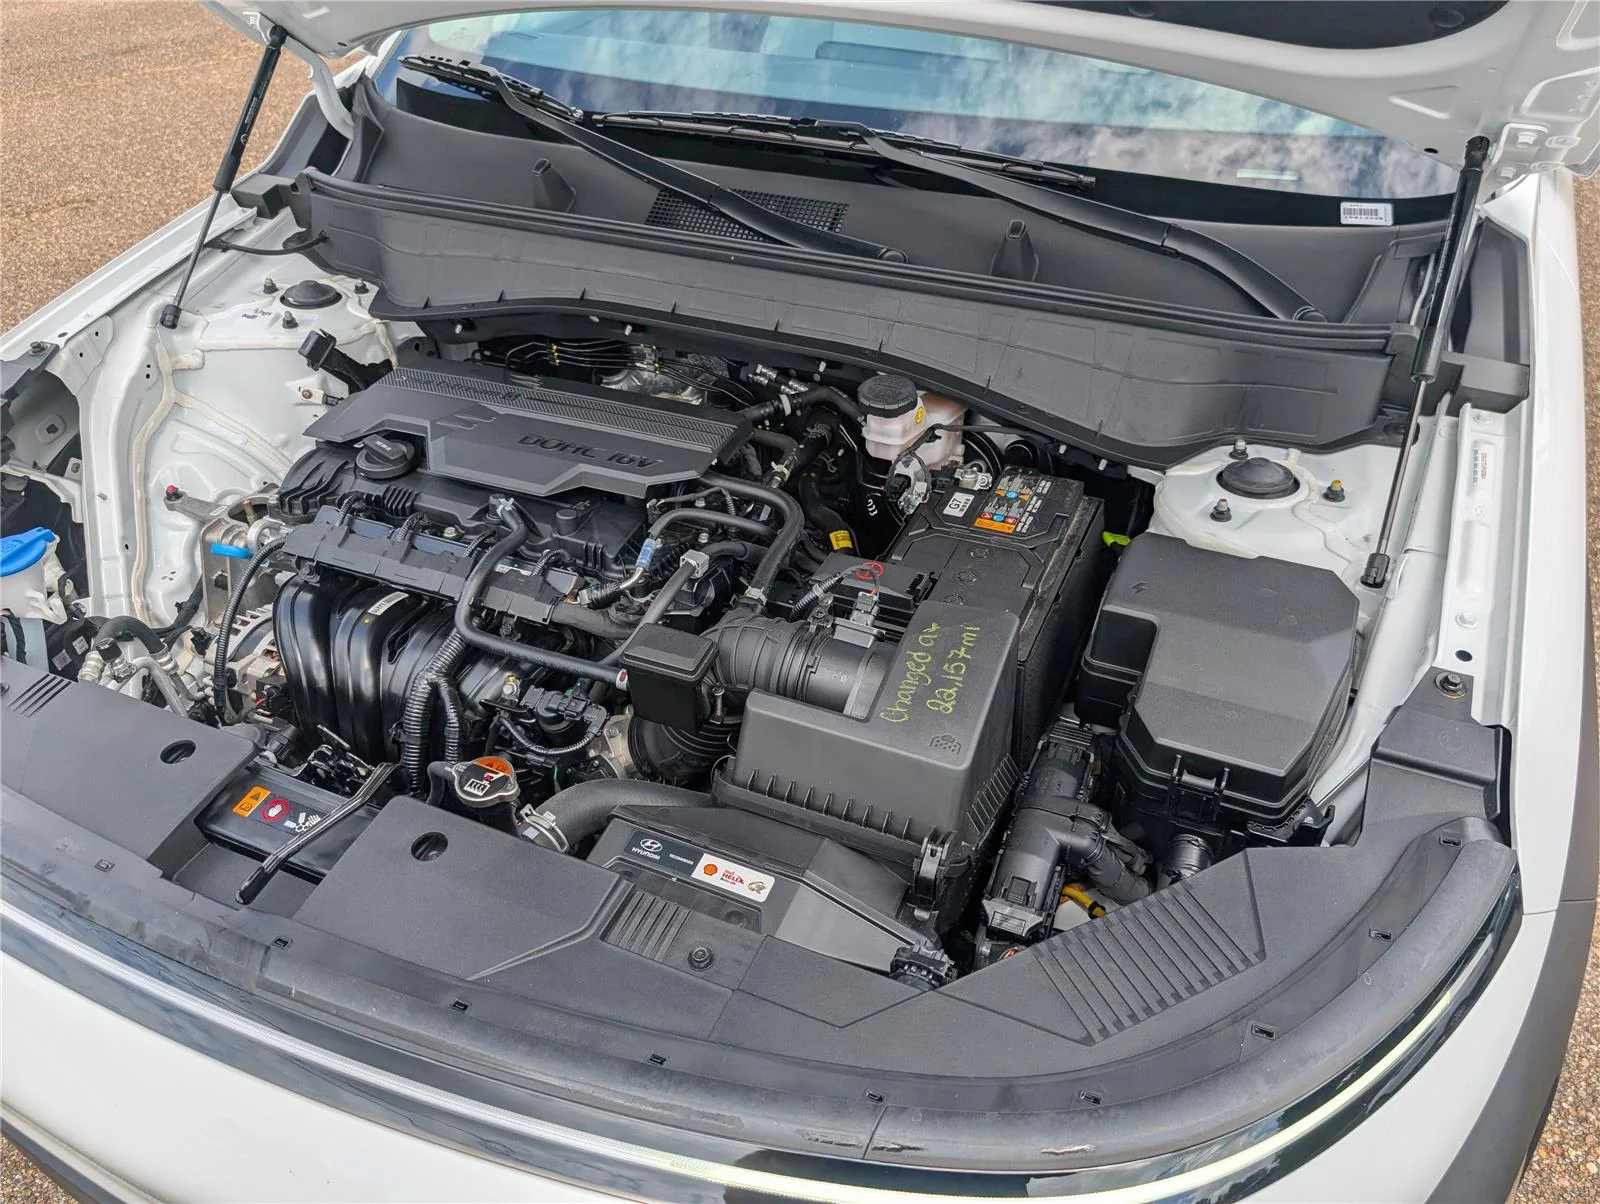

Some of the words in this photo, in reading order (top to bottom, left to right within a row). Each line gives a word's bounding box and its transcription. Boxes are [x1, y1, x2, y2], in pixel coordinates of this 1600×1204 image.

[518, 434, 606, 459] DOHC
[606, 451, 663, 469] 16V
[949, 498, 962, 509] G7
[880, 650, 931, 723] Changed
[631, 846, 661, 861] HYUNDAI
[722, 872, 745, 886] HELIX
